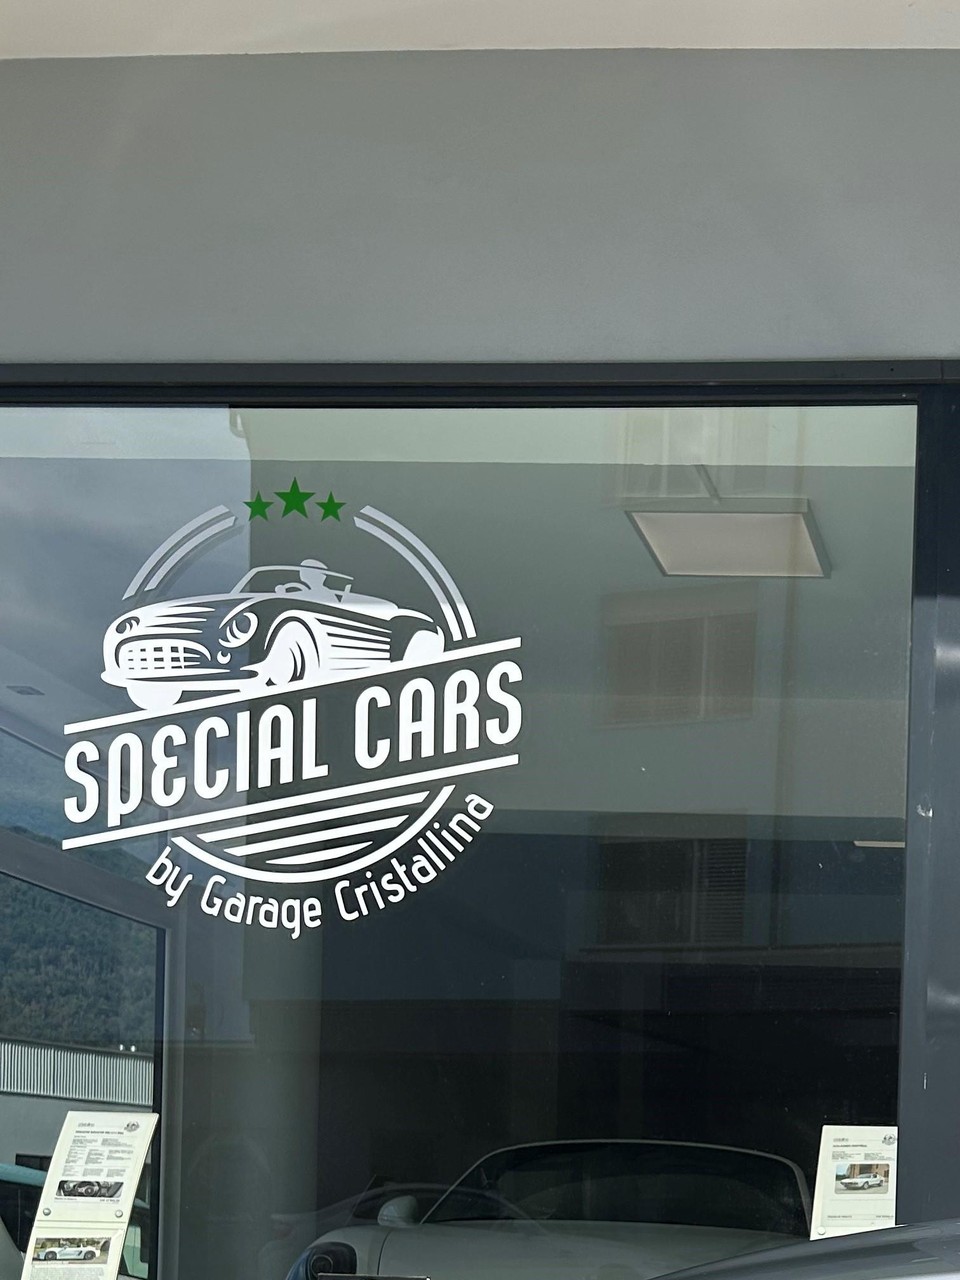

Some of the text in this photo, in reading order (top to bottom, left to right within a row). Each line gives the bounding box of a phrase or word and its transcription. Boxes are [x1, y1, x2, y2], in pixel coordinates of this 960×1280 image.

[63, 661, 523, 828] SPECIAL CARS
[145, 793, 495, 940] by Garage Cristallina
